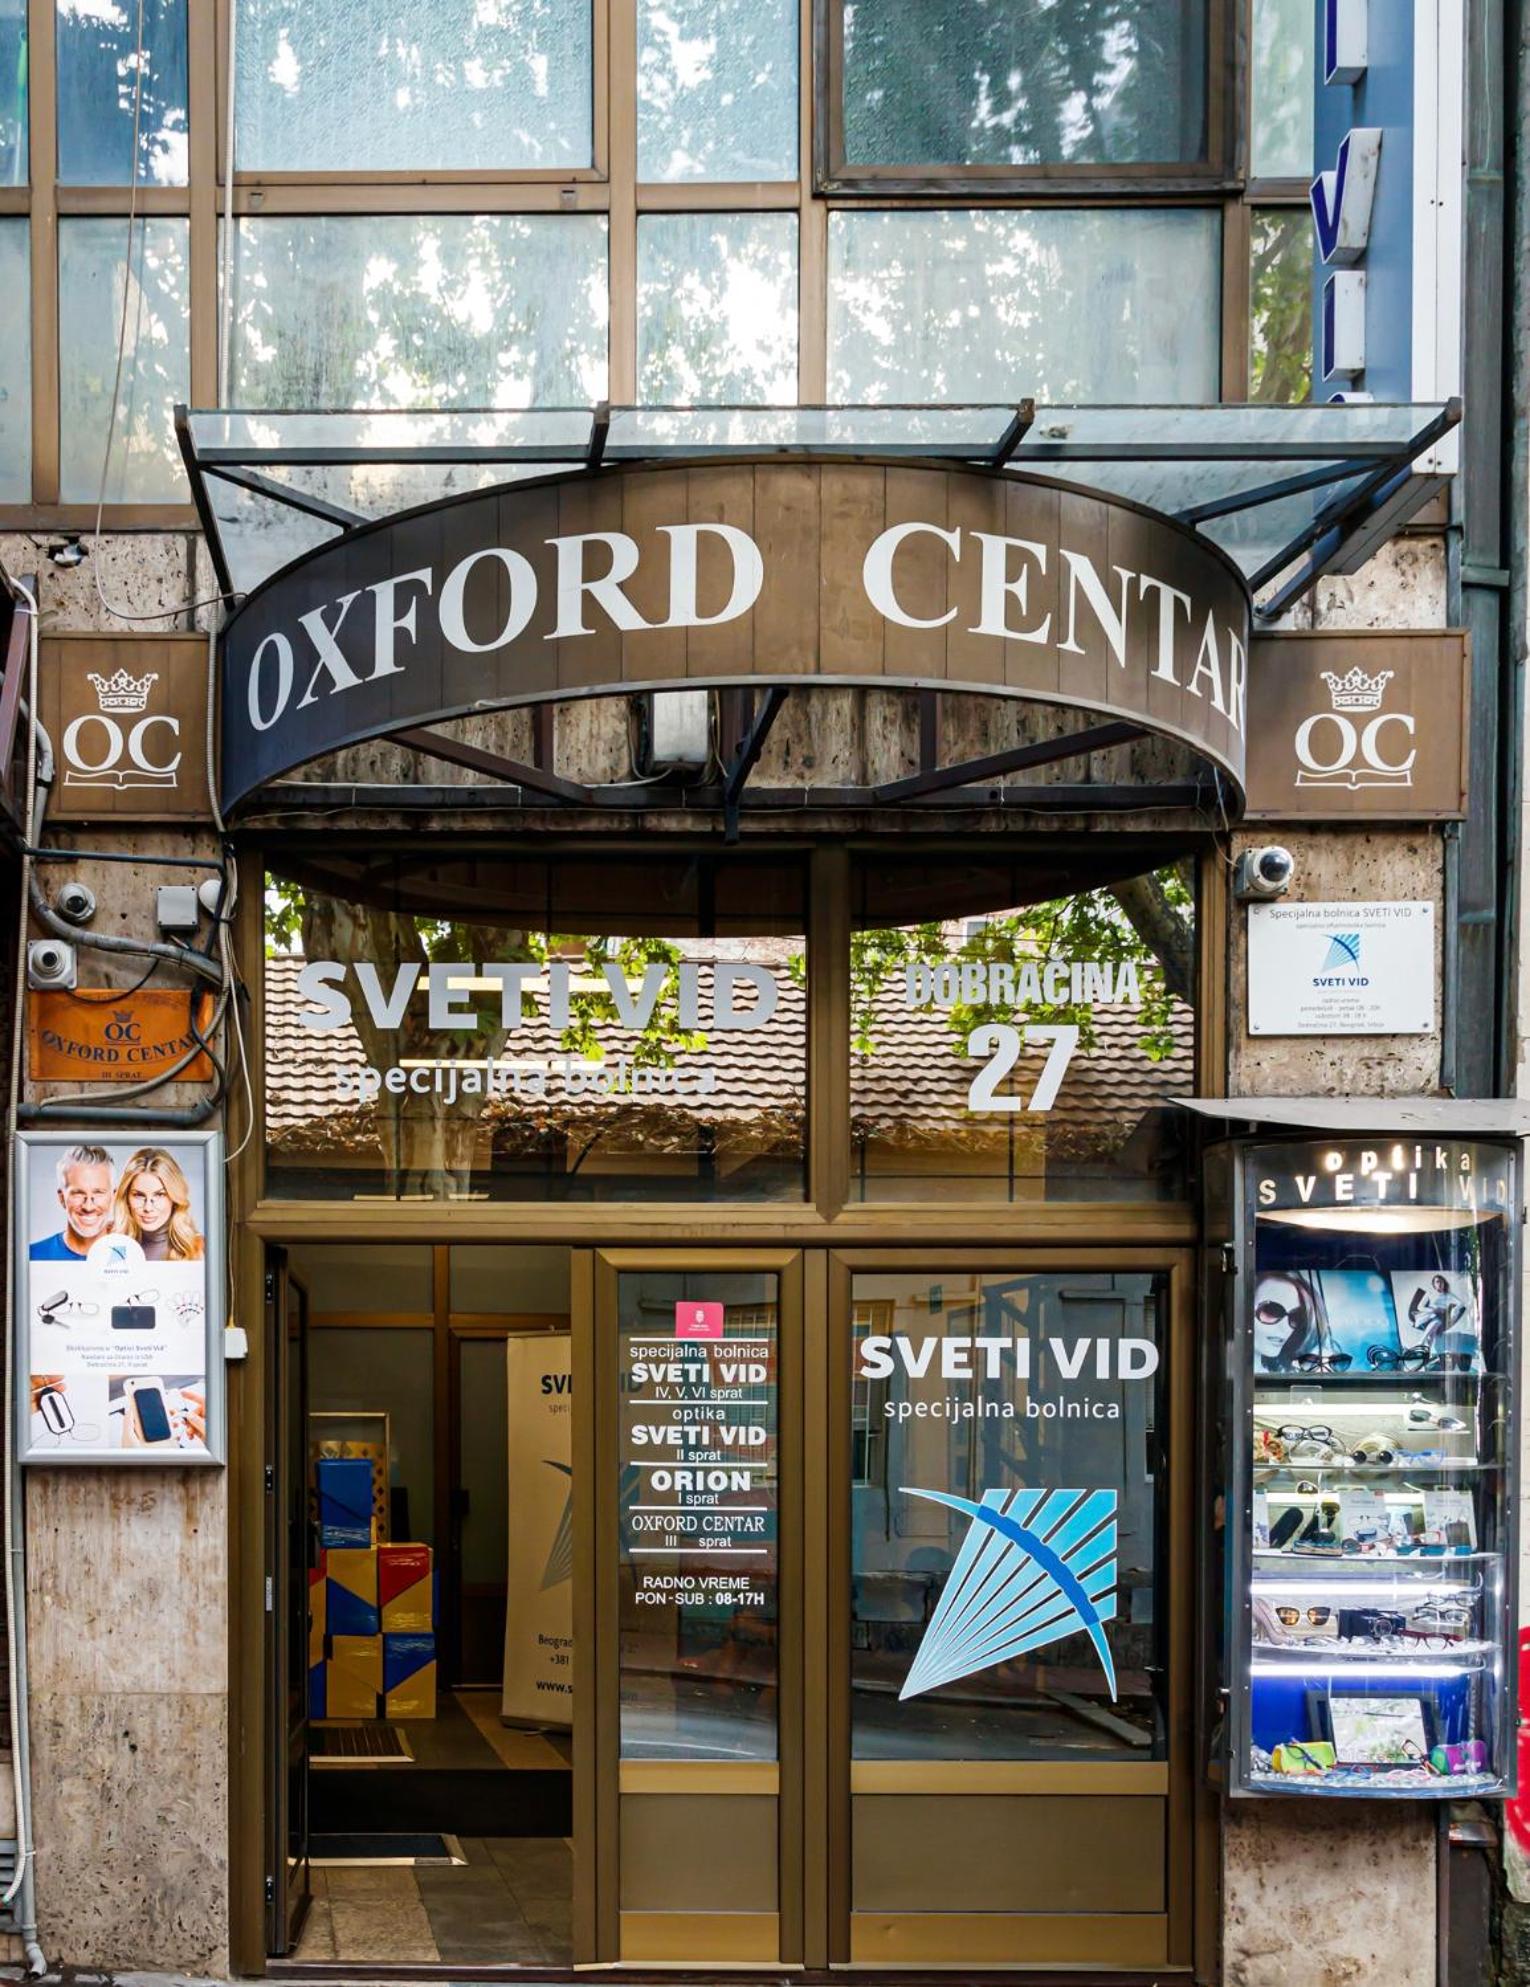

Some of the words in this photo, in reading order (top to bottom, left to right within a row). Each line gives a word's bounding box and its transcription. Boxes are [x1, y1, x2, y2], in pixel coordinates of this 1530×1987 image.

[248, 522, 764, 732] OXFORD
[862, 521, 1247, 744] CENTAR
[63, 714, 182, 773] OC
[1294, 712, 1417, 773] OC
[1269, 908, 1320, 920] Specijalna
[1324, 908, 1360, 918] bolnica
[1363, 907, 1391, 918] SVETI
[1394, 907, 1412, 918] VID
[904, 955, 1142, 1005] DOBRAČINA
[1313, 977, 1345, 987] SVETI
[1348, 977, 1369, 987] VID
[296, 960, 569, 1031] SVETI
[602, 961, 779, 1031] VID
[103, 1022, 141, 1042] OC
[42, 1029, 120, 1063] OXFORD
[967, 1022, 1080, 1113] 27
[336, 1056, 547, 1105] specijalna
[564, 1057, 716, 1095] bolnica
[1324, 1144, 1471, 1176] optika
[1258, 1172, 1418, 1205] SVETI
[1459, 1174, 1506, 1205] VID
[630, 1345, 707, 1361] specijalna
[713, 1345, 769, 1359] bolnica
[859, 1335, 1031, 1380] SVETI
[1048, 1337, 1160, 1381] VID
[631, 1363, 710, 1384] SVETI
[719, 1363, 768, 1384] VID
[692, 1386, 705, 1399] VI
[710, 1387, 742, 1401] sprat
[672, 1406, 726, 1423] optika
[884, 1395, 1014, 1424] specijalna
[1026, 1396, 1119, 1419] bolnica
[631, 1425, 710, 1446] SVETI
[719, 1425, 767, 1446] VID
[677, 1449, 684, 1461] II
[688, 1449, 721, 1464] sprat
[651, 1470, 750, 1492] ORION
[686, 1493, 719, 1508] sprat
[631, 1515, 698, 1532] OXFORD
[702, 1516, 765, 1532] CENTAR
[665, 1535, 677, 1547] III
[698, 1535, 732, 1549] sprat
[643, 1576, 695, 1589] RADNO
[700, 1577, 750, 1590] VREME
[715, 1592, 764, 1605] 08-17H
